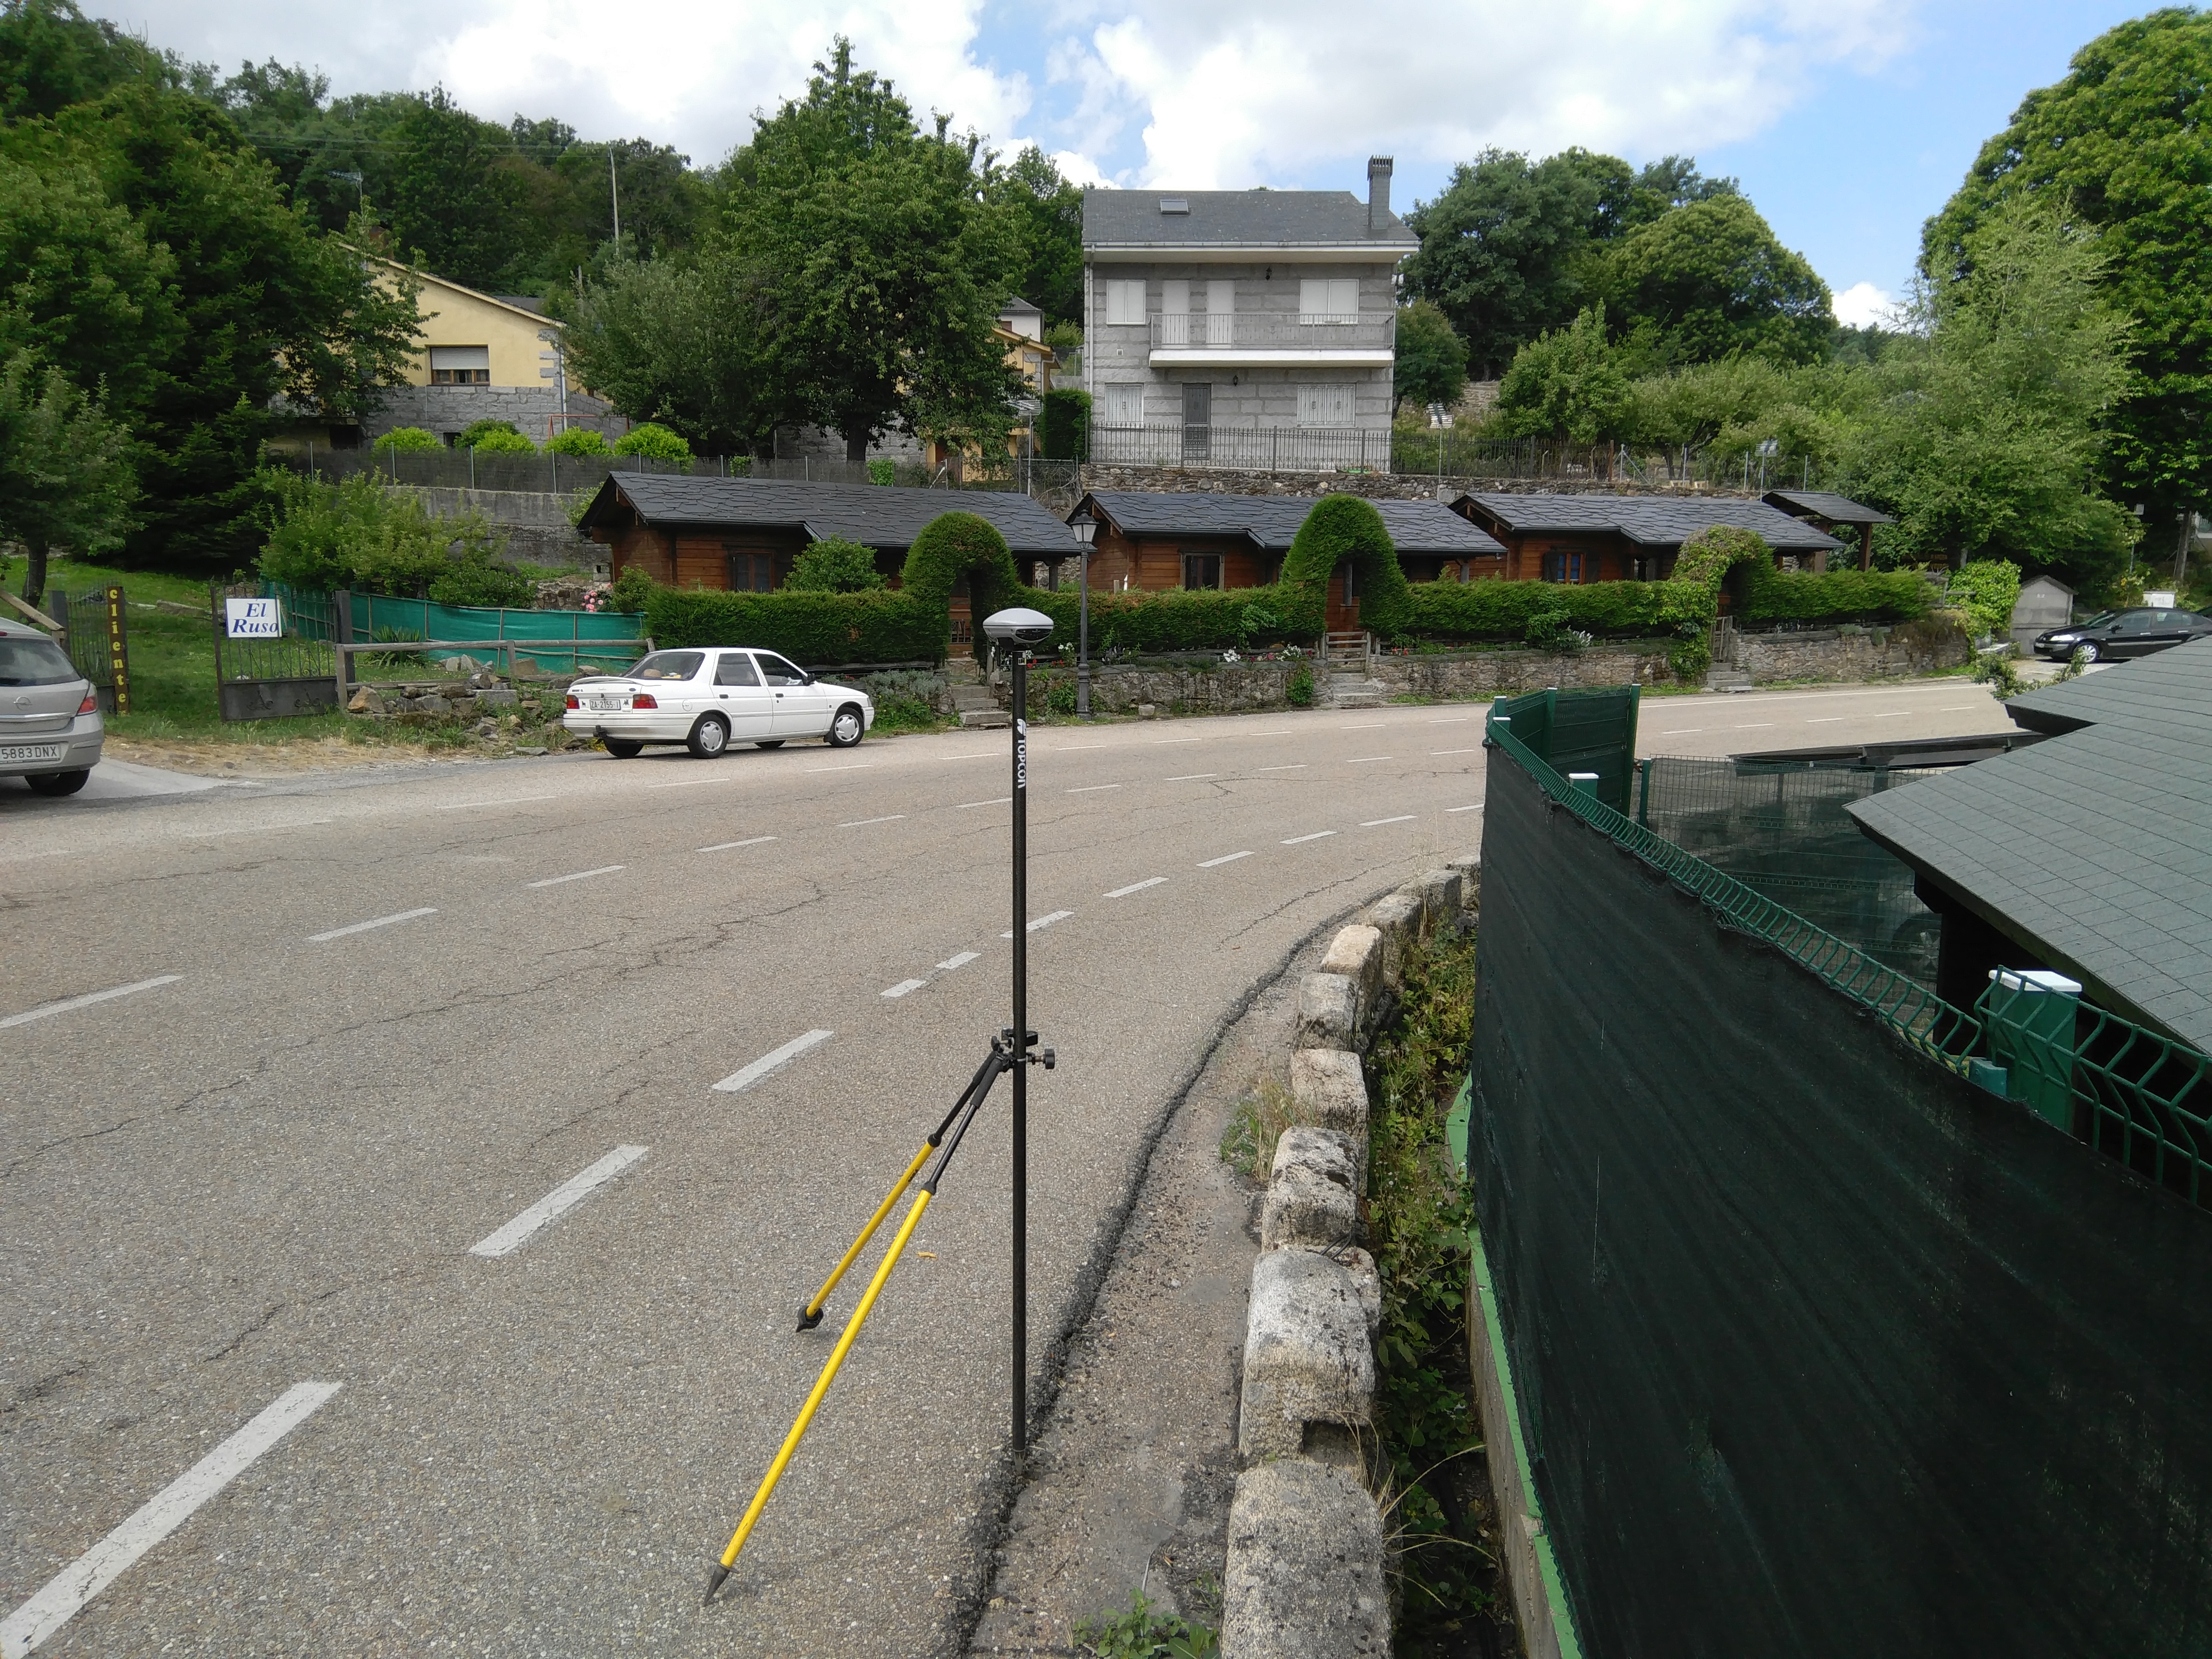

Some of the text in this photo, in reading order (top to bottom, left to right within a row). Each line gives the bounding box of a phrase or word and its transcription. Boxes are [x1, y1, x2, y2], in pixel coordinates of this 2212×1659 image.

[245, 602, 266, 617] El
[231, 618, 278, 633] Ruso
[1, 746, 57, 759] 5883 DNX
